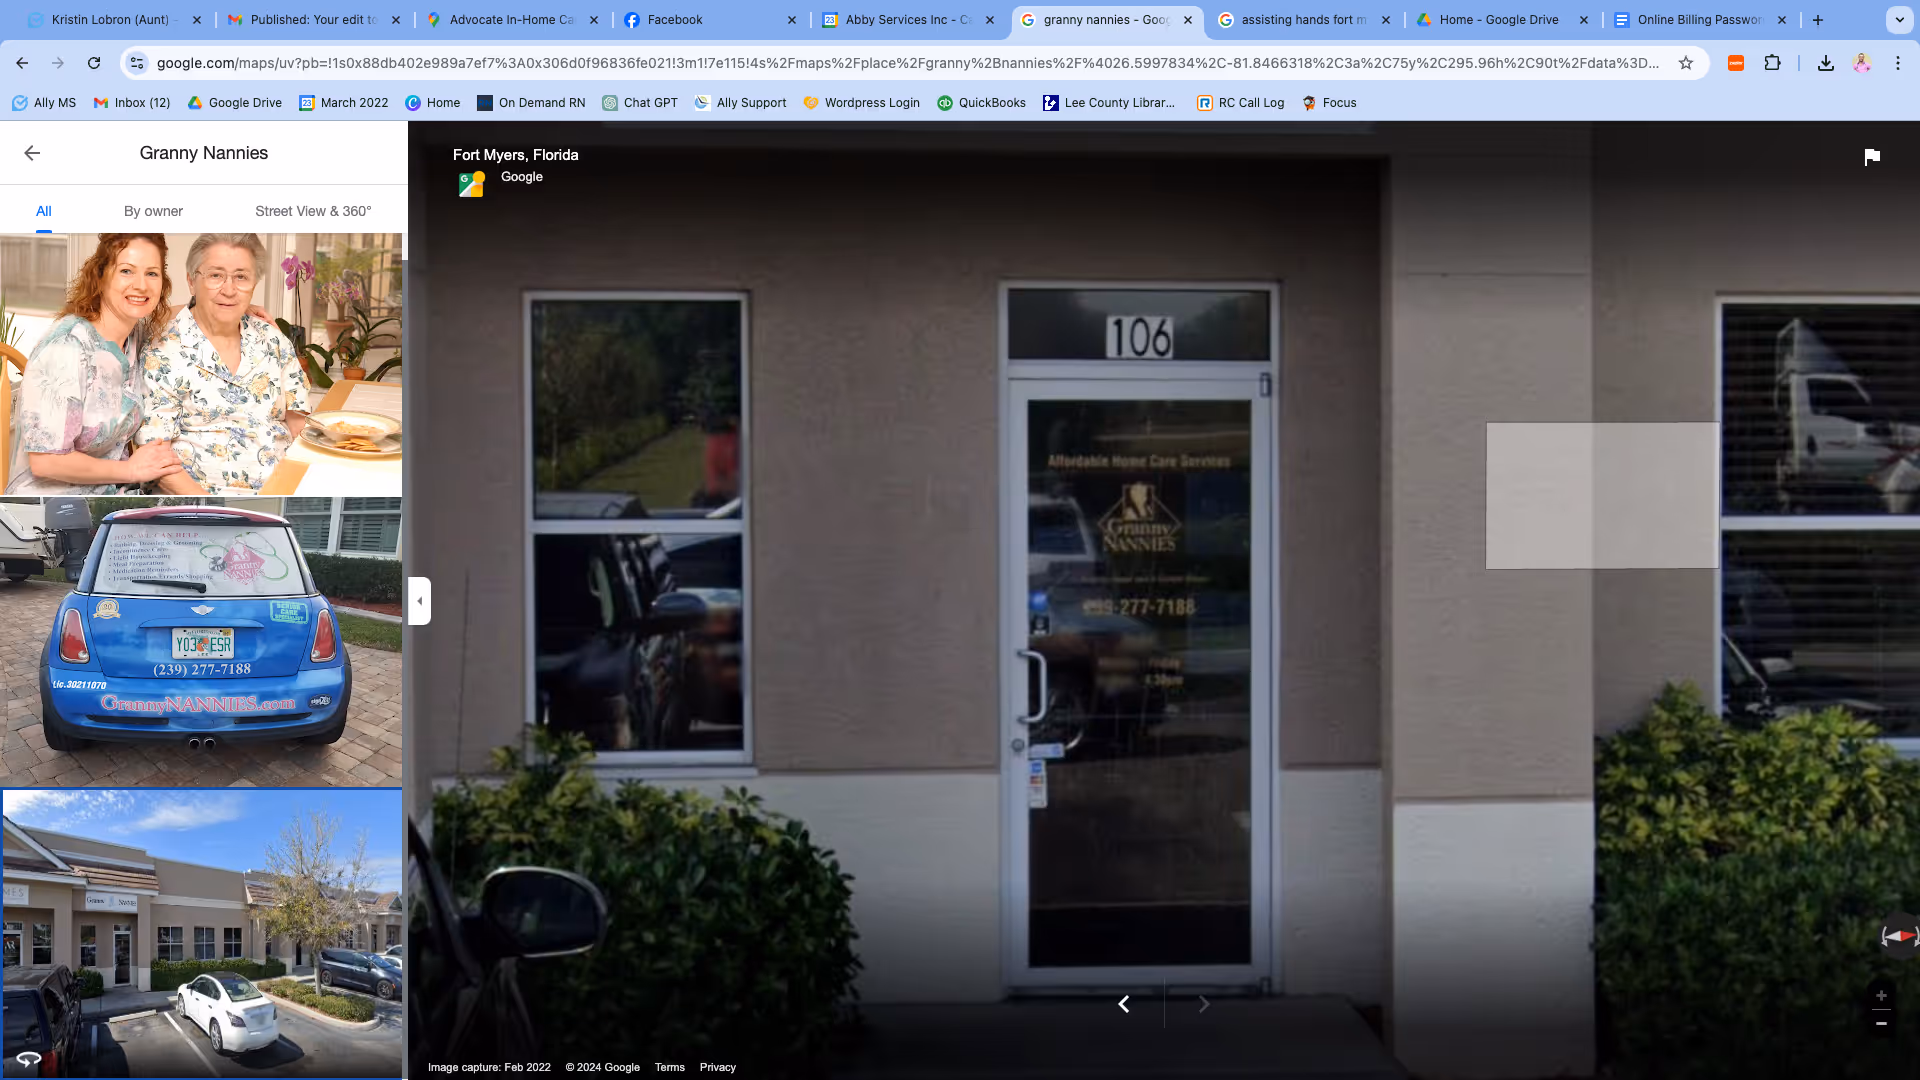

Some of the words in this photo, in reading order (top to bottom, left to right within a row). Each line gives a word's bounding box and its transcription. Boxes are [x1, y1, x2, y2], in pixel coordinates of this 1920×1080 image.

[53, 13, 89, 25] Kristin
[92, 13, 131, 25] Lobron
[134, 13, 169, 27] (Aunt)
[251, 13, 310, 25] Published:
[314, 14, 340, 25] Your
[342, 13, 364, 25] edit
[450, 13, 503, 25] Advocate
[506, 14, 556, 25] In-Home
[648, 13, 703, 25] Facebook
[846, 13, 875, 27] Abby
[878, 13, 927, 25] Services
[930, 14, 948, 25] Inc
[1043, 16, 1083, 28] granny
[1086, 13, 1131, 25] nannies
[1242, 13, 1292, 27] assisting
[1295, 13, 1330, 25] hands
[1333, 13, 1354, 25] fort
[1440, 14, 1474, 25] Home
[1486, 13, 1527, 27] Google
[1530, 13, 1560, 25] Drive
[1638, 13, 1675, 25] Online
[1677, 13, 1712, 27] Billing
[33, 96, 56, 110] Ally
[58, 97, 77, 108] MS
[115, 96, 146, 108] Inbox
[149, 96, 171, 110] (12)
[208, 97, 249, 110] Google
[252, 96, 283, 108] Drive
[321, 96, 357, 108] March
[359, 97, 389, 108] 2022
[427, 97, 461, 108] Home
[499, 97, 516, 108] On
[519, 96, 566, 108] Demand
[569, 97, 586, 108] RN
[623, 96, 651, 108] Chat
[653, 97, 679, 108] GPT
[716, 96, 738, 110] Ally
[741, 97, 787, 110] Support
[824, 96, 886, 110] Wordpress
[889, 97, 920, 110] Login
[958, 96, 1027, 109] QuickBooks
[1065, 97, 1086, 108] Lee
[1088, 97, 1129, 110] County
[1132, 96, 1175, 108] Librar...
[1219, 97, 1236, 108] RC
[1238, 96, 1260, 108] Call
[1263, 97, 1285, 110] Log
[1323, 97, 1357, 108] Focus
[139, 144, 199, 164] Granny
[203, 145, 269, 160] Nannies
[35, 205, 52, 217] All
[124, 205, 141, 220] By
[144, 207, 184, 217] owner
[255, 204, 293, 217] Street
[296, 205, 327, 217] View
[329, 205, 340, 217] &
[342, 204, 372, 217] 360°
[1112, 317, 1172, 358] 106
[1048, 454, 1109, 468] Affordable
[1112, 454, 1147, 468] Home
[1150, 454, 1178, 468] Care
[1181, 455, 1231, 468] Services
[1107, 517, 1170, 537] Granny
[280, 608, 299, 616] CARE
[210, 636, 232, 652] ESR
[153, 662, 188, 678] (239)
[191, 662, 252, 676] 277-7188
[101, 694, 296, 715] GrannyNANNIES.com
